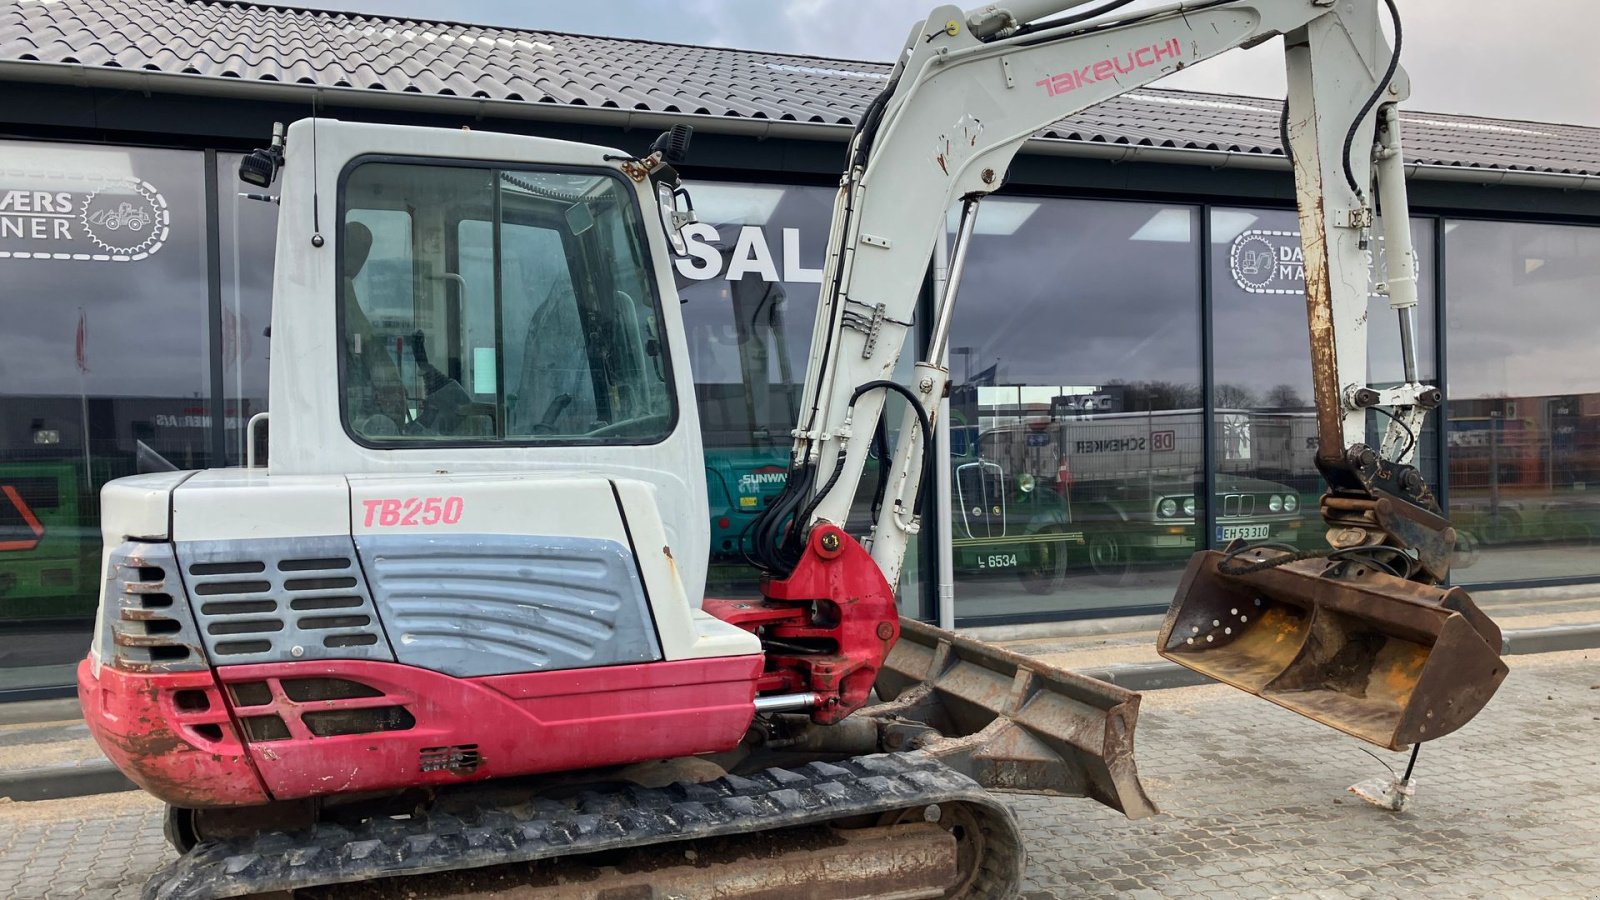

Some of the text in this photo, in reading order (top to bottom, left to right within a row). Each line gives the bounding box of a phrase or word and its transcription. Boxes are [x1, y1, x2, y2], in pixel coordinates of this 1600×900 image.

[1, 217, 73, 240] NER
[742, 473, 788, 484] SUNWA
[362, 495, 465, 528] TB250
[1223, 526, 1268, 539] EH 53 310
[988, 554, 1017, 568] 6534
